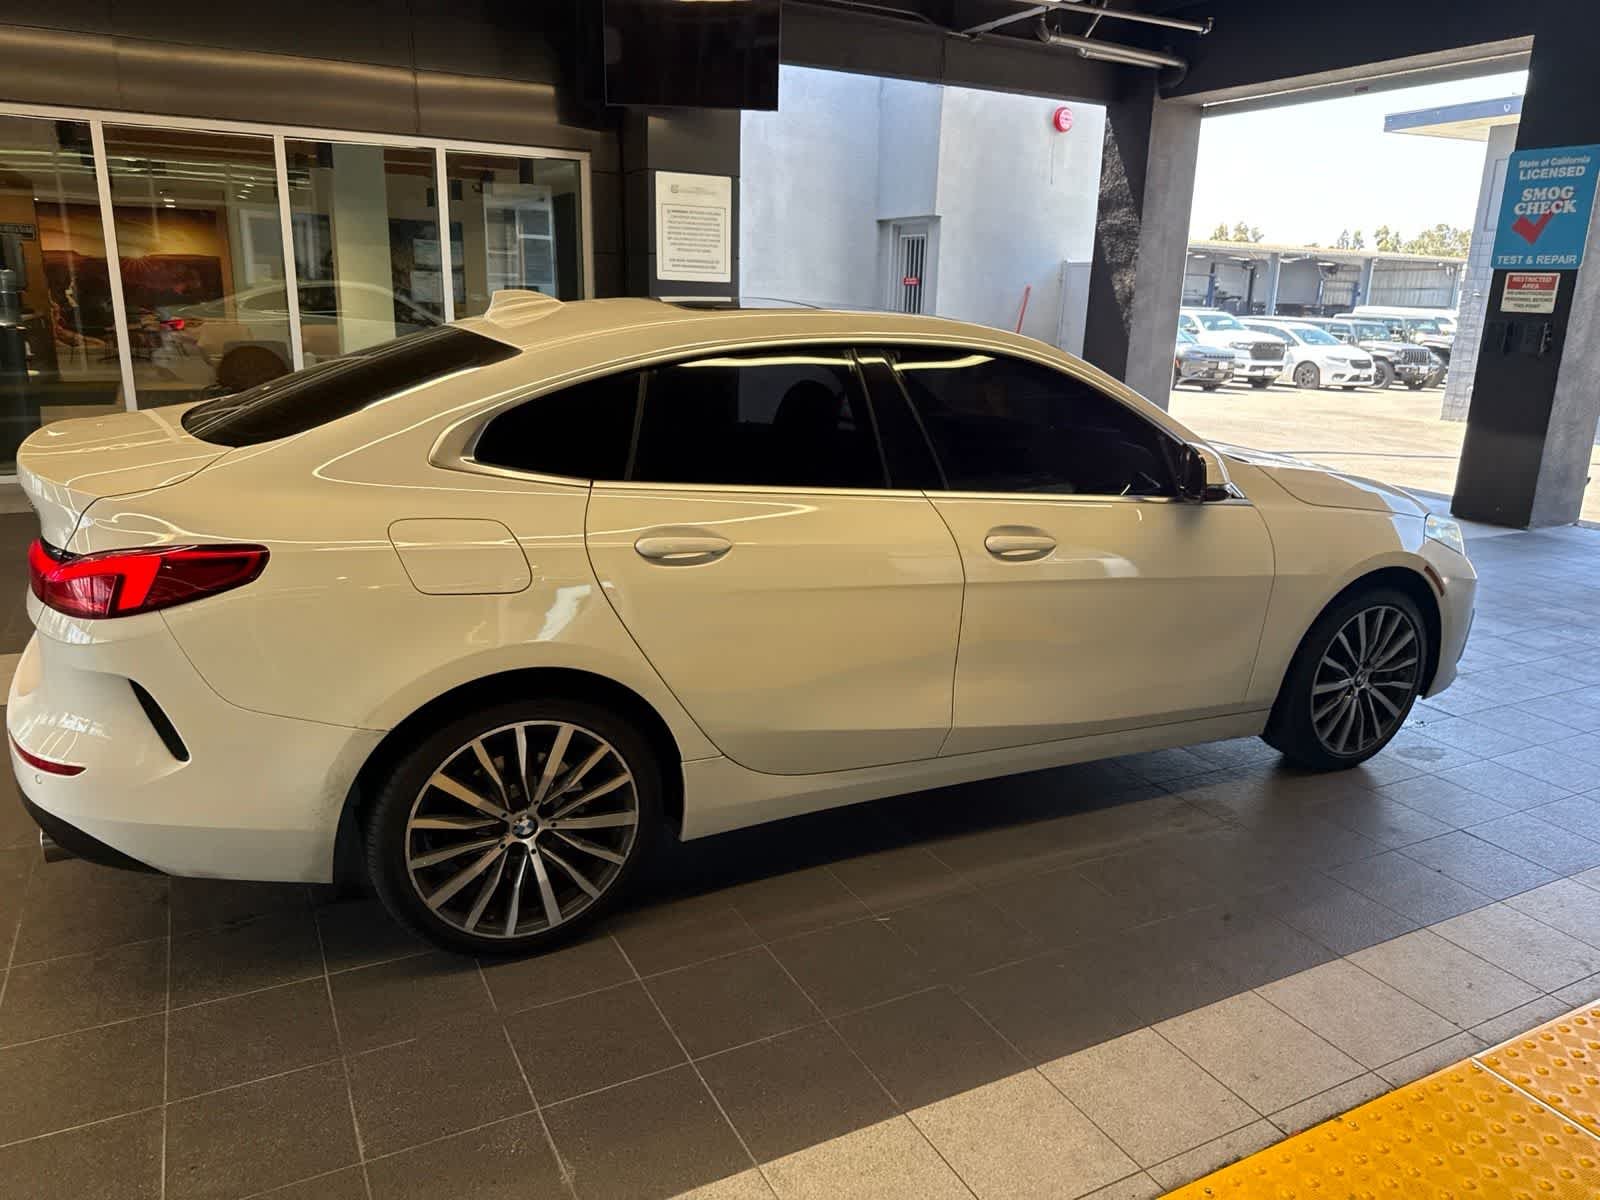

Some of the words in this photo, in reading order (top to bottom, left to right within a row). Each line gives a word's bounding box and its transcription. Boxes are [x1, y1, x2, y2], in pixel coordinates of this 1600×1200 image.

[1519, 160, 1539, 168] State
[1541, 158, 1549, 166] of
[1551, 155, 1591, 166] California
[1519, 166, 1585, 180] LICENSED
[1521, 186, 1575, 201] SMOG
[1514, 200, 1576, 215] CHECK
[1497, 256, 1524, 264] TEST
[1525, 256, 1534, 264] &
[1535, 255, 1577, 264] REPAIR
